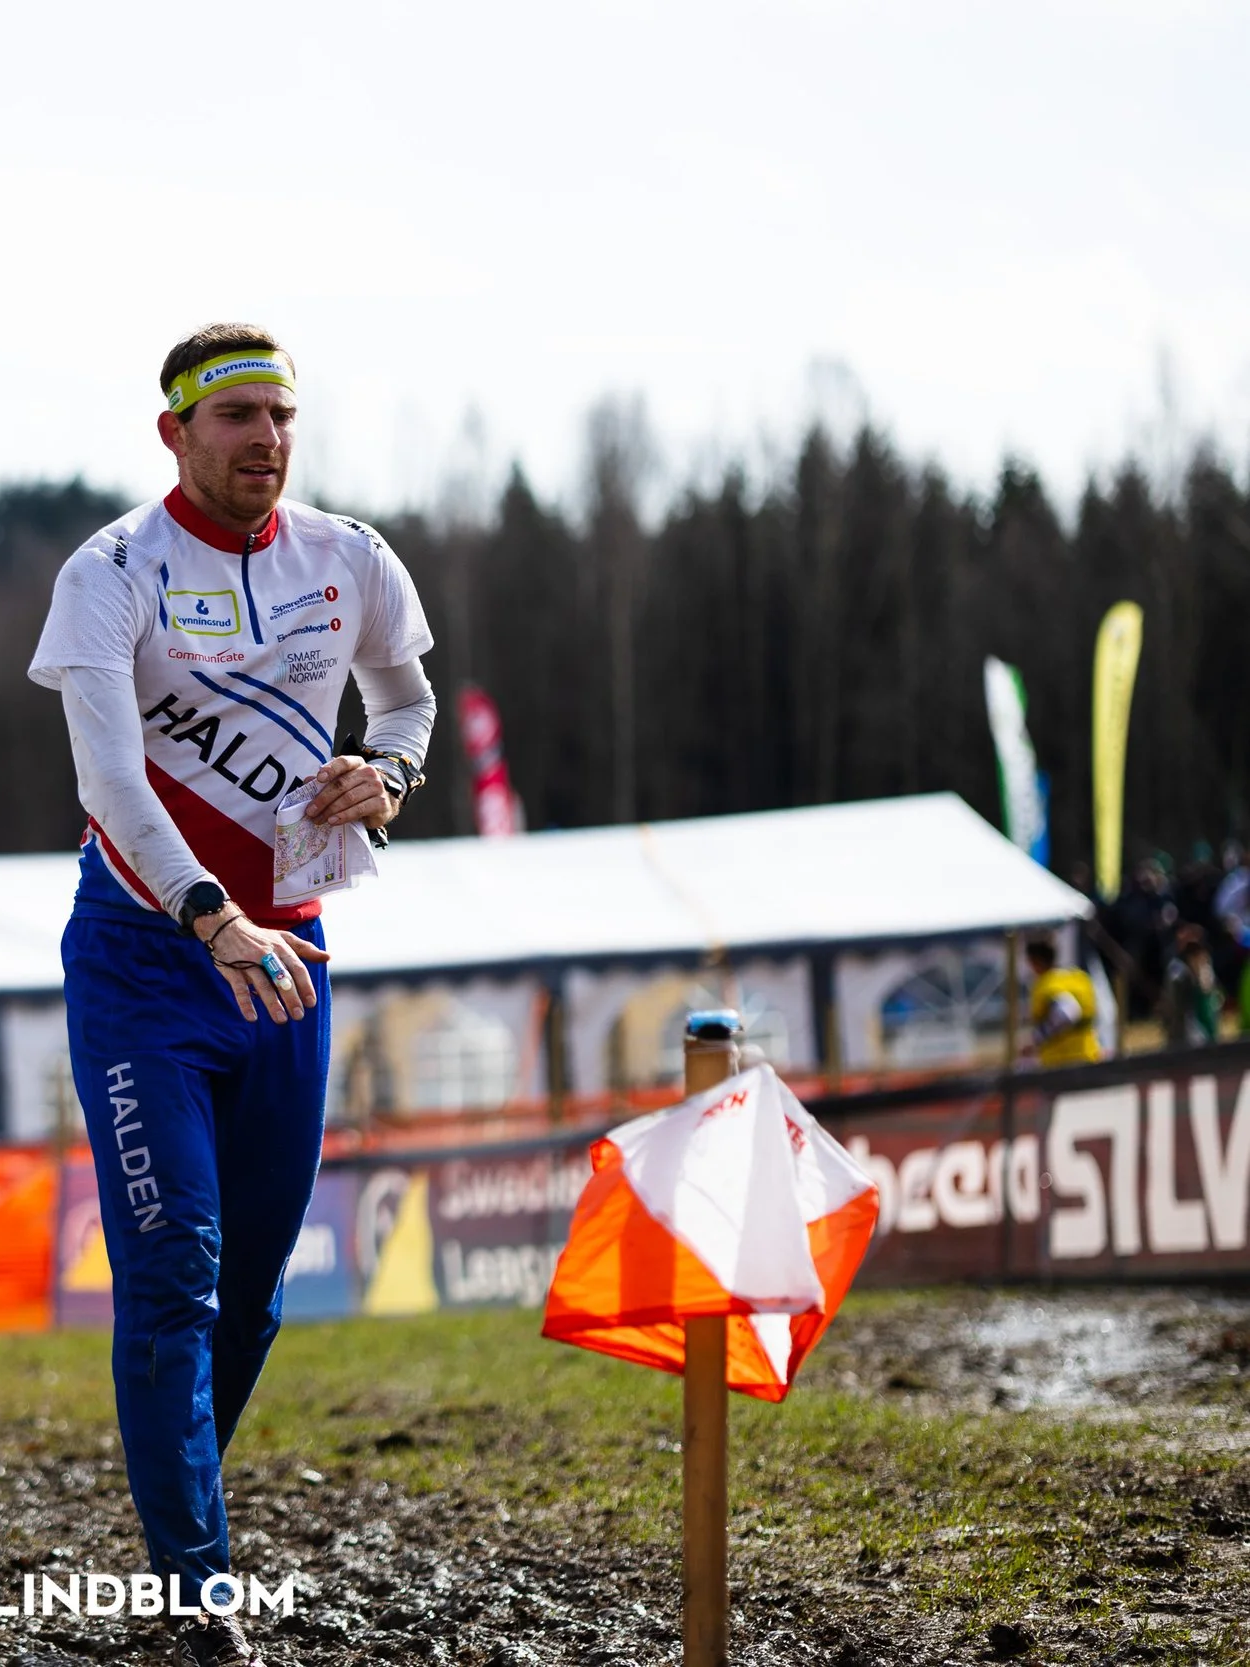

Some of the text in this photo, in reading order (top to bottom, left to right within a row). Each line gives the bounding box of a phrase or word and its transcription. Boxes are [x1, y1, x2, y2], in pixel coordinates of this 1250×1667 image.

[271, 589, 324, 614] SpareBank
[168, 648, 245, 663] Communicate
[287, 649, 321, 663] SMART
[288, 669, 328, 684] NORWAY
[107, 1062, 168, 1233] HALDEN
